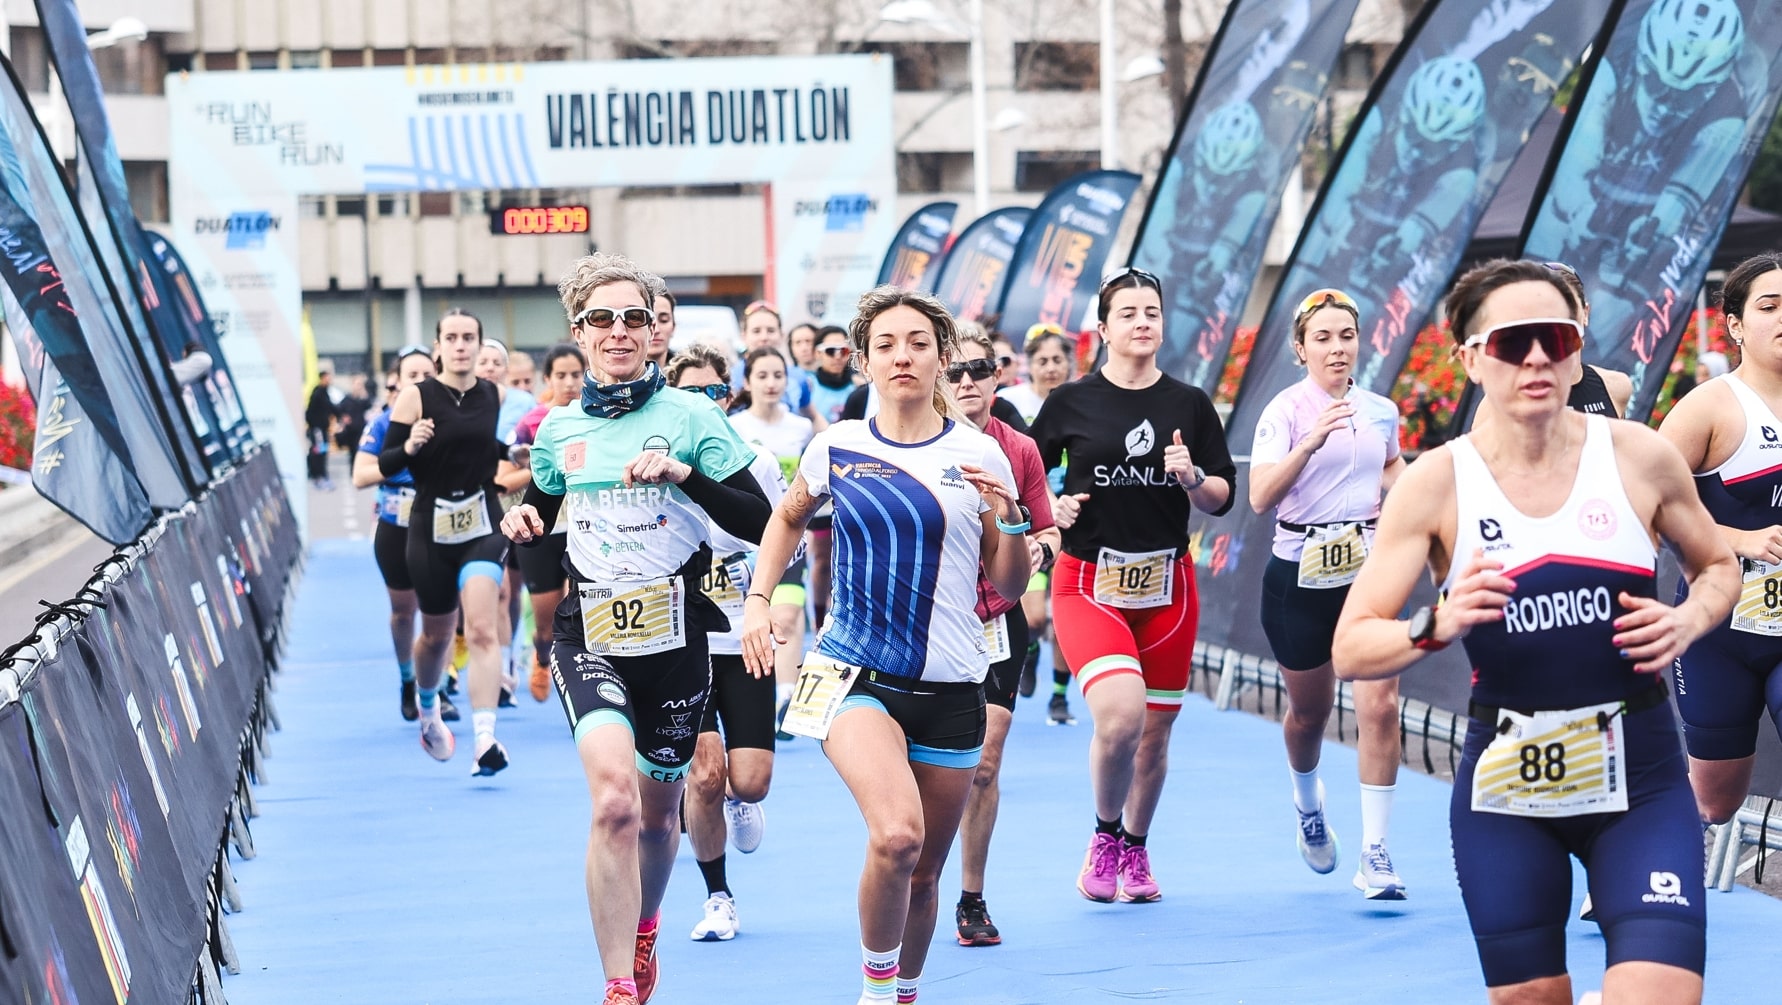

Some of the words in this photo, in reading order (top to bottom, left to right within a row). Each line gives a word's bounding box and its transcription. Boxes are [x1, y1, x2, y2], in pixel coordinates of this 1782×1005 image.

[208, 101, 271, 124] RUN
[708, 82, 849, 143] DUATLÓN
[233, 120, 306, 146] BIKE
[281, 144, 344, 166] RUN
[598, 483, 674, 511] BÉTERA
[449, 508, 473, 529] 123
[616, 522, 658, 534] Simetria
[615, 540, 646, 553] BÉTERA
[1319, 541, 1352, 568] 101
[1117, 565, 1153, 589] 102
[611, 598, 645, 631] 92
[1503, 586, 1611, 634] RODRIGO
[1519, 742, 1566, 782] 88
[650, 769, 685, 783] CEA
